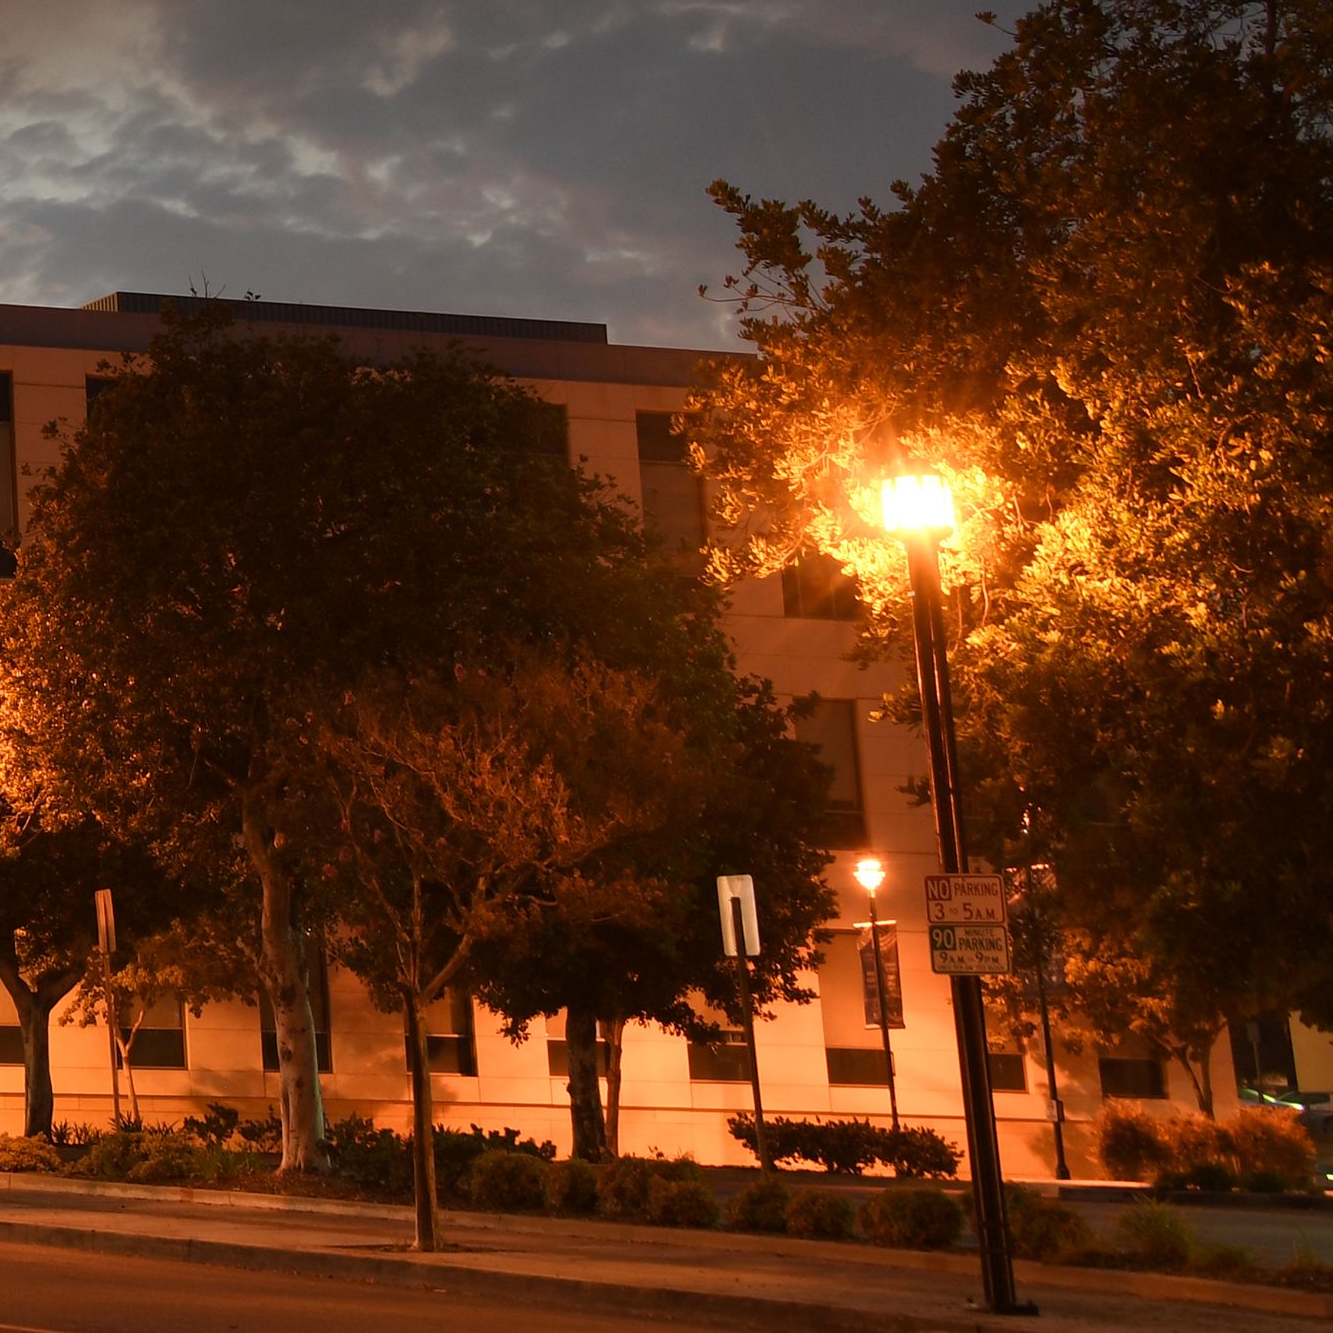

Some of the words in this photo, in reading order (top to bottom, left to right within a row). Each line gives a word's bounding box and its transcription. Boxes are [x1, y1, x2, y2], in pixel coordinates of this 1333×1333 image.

[927, 879, 951, 900] NO
[954, 882, 998, 897] PARKING
[934, 902, 945, 920] 3
[932, 928, 954, 949] 90
[958, 937, 1003, 952] PARKING
